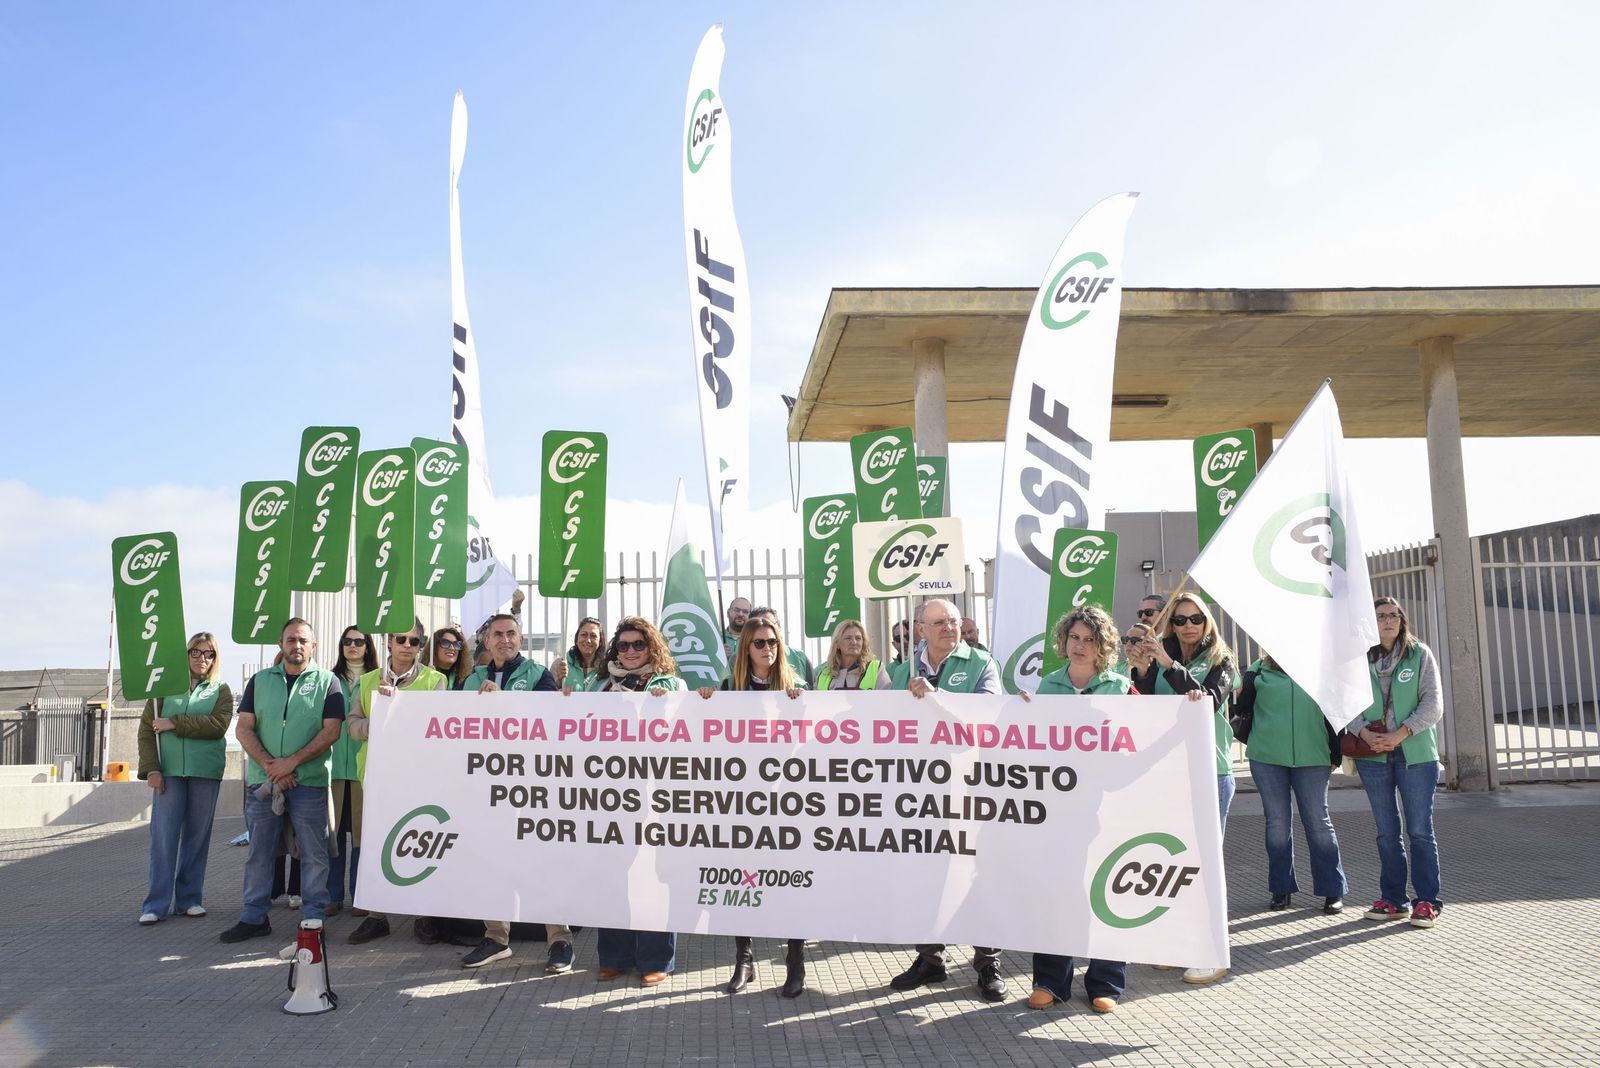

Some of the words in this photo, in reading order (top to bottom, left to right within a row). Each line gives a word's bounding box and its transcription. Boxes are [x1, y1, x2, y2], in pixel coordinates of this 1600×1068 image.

[1055, 276, 1115, 303] CSIF
[314, 445, 352, 462] CSIF
[425, 457, 462, 476] CSIF
[559, 451, 600, 469] CSIF
[870, 447, 907, 469] CSIF
[1210, 450, 1248, 471] CSIF
[372, 469, 408, 490] CSIF
[919, 480, 939, 497] SIF
[254, 500, 290, 516] CSIF
[817, 510, 851, 526] CSIF
[307, 482, 334, 585] CSIF
[426, 494, 448, 590] CSIF
[560, 490, 584, 591] CSIF
[130, 551, 171, 570] CSIF
[375, 511, 394, 626] CSIF
[1069, 547, 1110, 565] CSIF
[250, 537, 275, 638] CSIF
[823, 543, 840, 631] CSIF
[919, 581, 952, 590] SEVILLA
[141, 589, 165, 692] CSIF
[662, 618, 720, 682] CSIF
[426, 718, 547, 740] AGENCIA
[558, 713, 691, 742] PÚBLICA
[703, 720, 860, 743] PUERTOS
[874, 720, 917, 744] DE
[931, 720, 1136, 752] ANDALUCÍA
[468, 753, 525, 776] POR
[535, 755, 573, 777] UN
[584, 756, 746, 781] CONVENIO
[759, 758, 951, 784] COLECTIVO
[964, 762, 1077, 791] JUSTO
[491, 785, 548, 809] POR
[559, 787, 641, 812] UNOS
[652, 790, 825, 816] SERVICIOS
[839, 793, 882, 817] DE
[895, 793, 1046, 824] CALIDAD
[395, 830, 459, 859] CSIF
[517, 818, 576, 842] POR
[587, 821, 625, 845] LA
[635, 823, 801, 850] IGUALDAD
[814, 827, 977, 855] SALARIAL
[1111, 861, 1200, 898] CSIF
[697, 888, 718, 905] ES
[723, 886, 763, 907] MÁS
